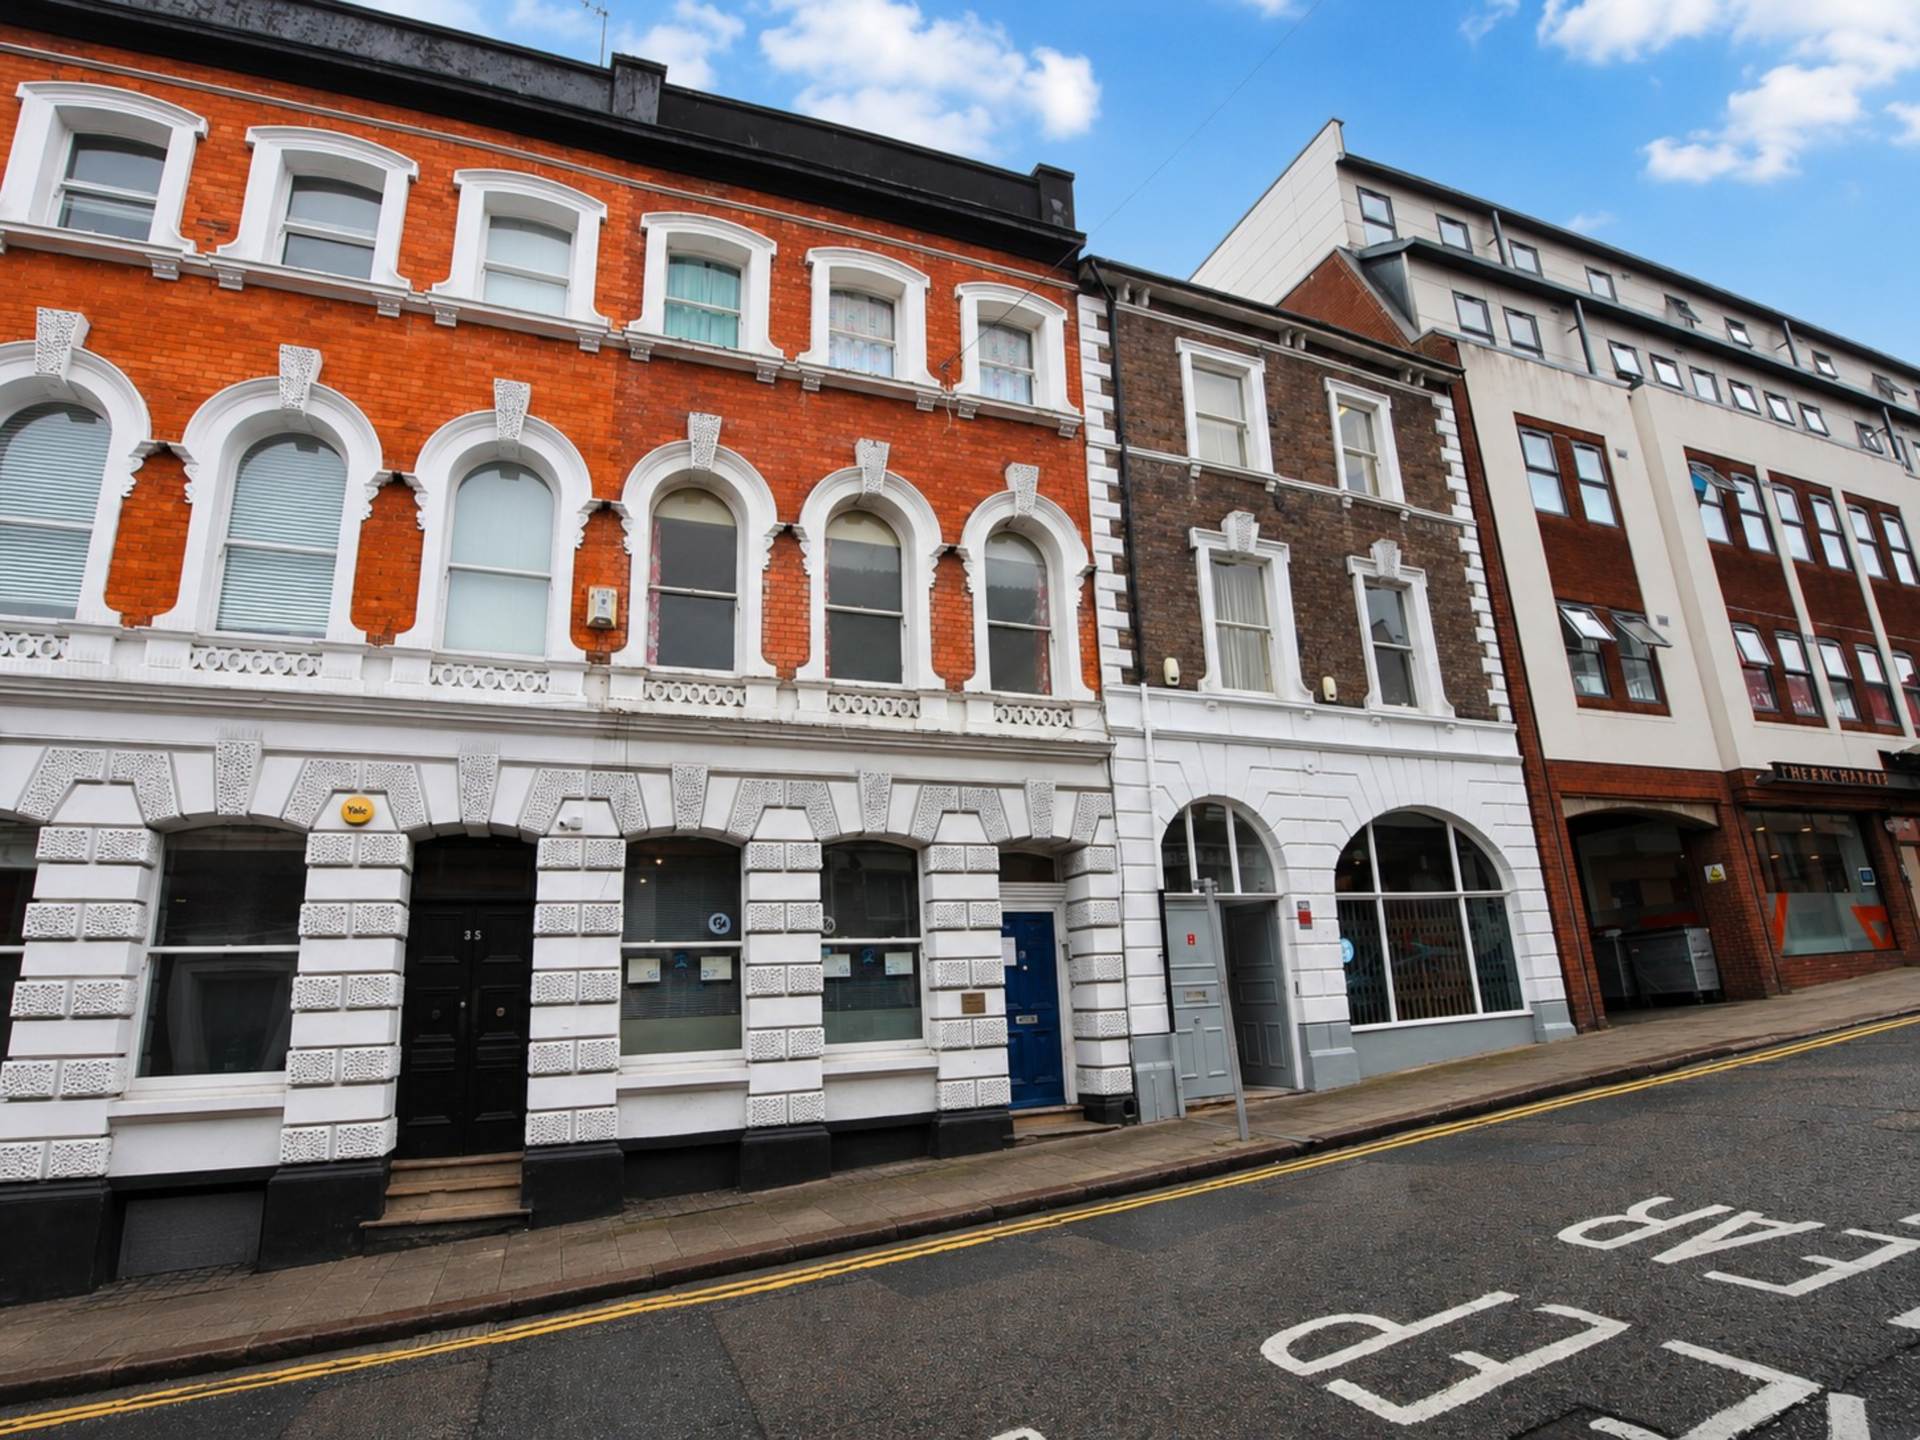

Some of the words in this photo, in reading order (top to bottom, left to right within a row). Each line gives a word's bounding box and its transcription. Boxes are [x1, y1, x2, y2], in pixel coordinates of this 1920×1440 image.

[1781, 765, 1808, 780] THE
[347, 804, 368, 815] Yale
[464, 930, 482, 941] 35
[1260, 1291, 1920, 1440] EEP
